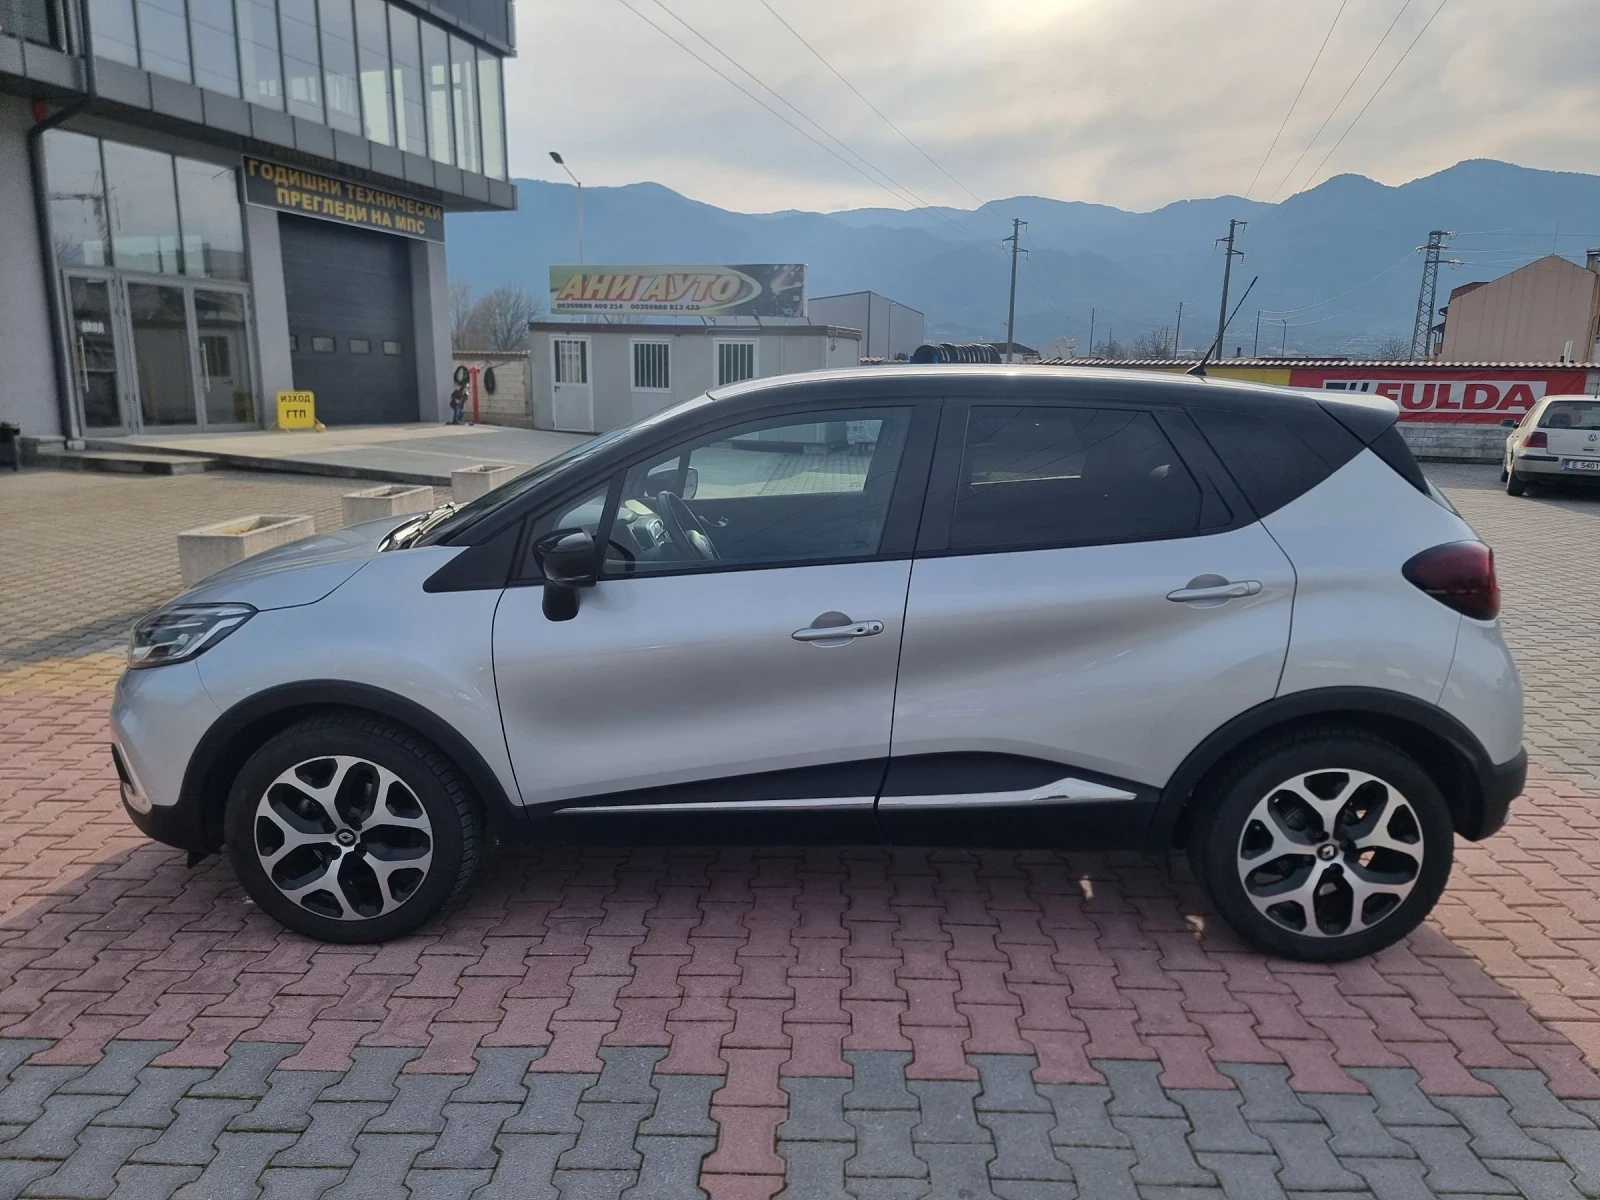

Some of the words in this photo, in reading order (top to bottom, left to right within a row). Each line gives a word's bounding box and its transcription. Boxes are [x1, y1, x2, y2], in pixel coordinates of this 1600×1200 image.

[248, 159, 342, 194] ГОДИШНИ
[345, 184, 442, 221] ТЕХНИЧЕСКИ
[276, 187, 368, 223] ПРЕГЛЕДИ
[371, 210, 393, 228] НА
[395, 215, 426, 235] МПС
[555, 274, 643, 301] АНИ
[638, 273, 742, 303] АУТО
[280, 395, 311, 403] ИЗХОД
[1375, 382, 1537, 411] FULDA
[286, 409, 307, 419] ГТП
